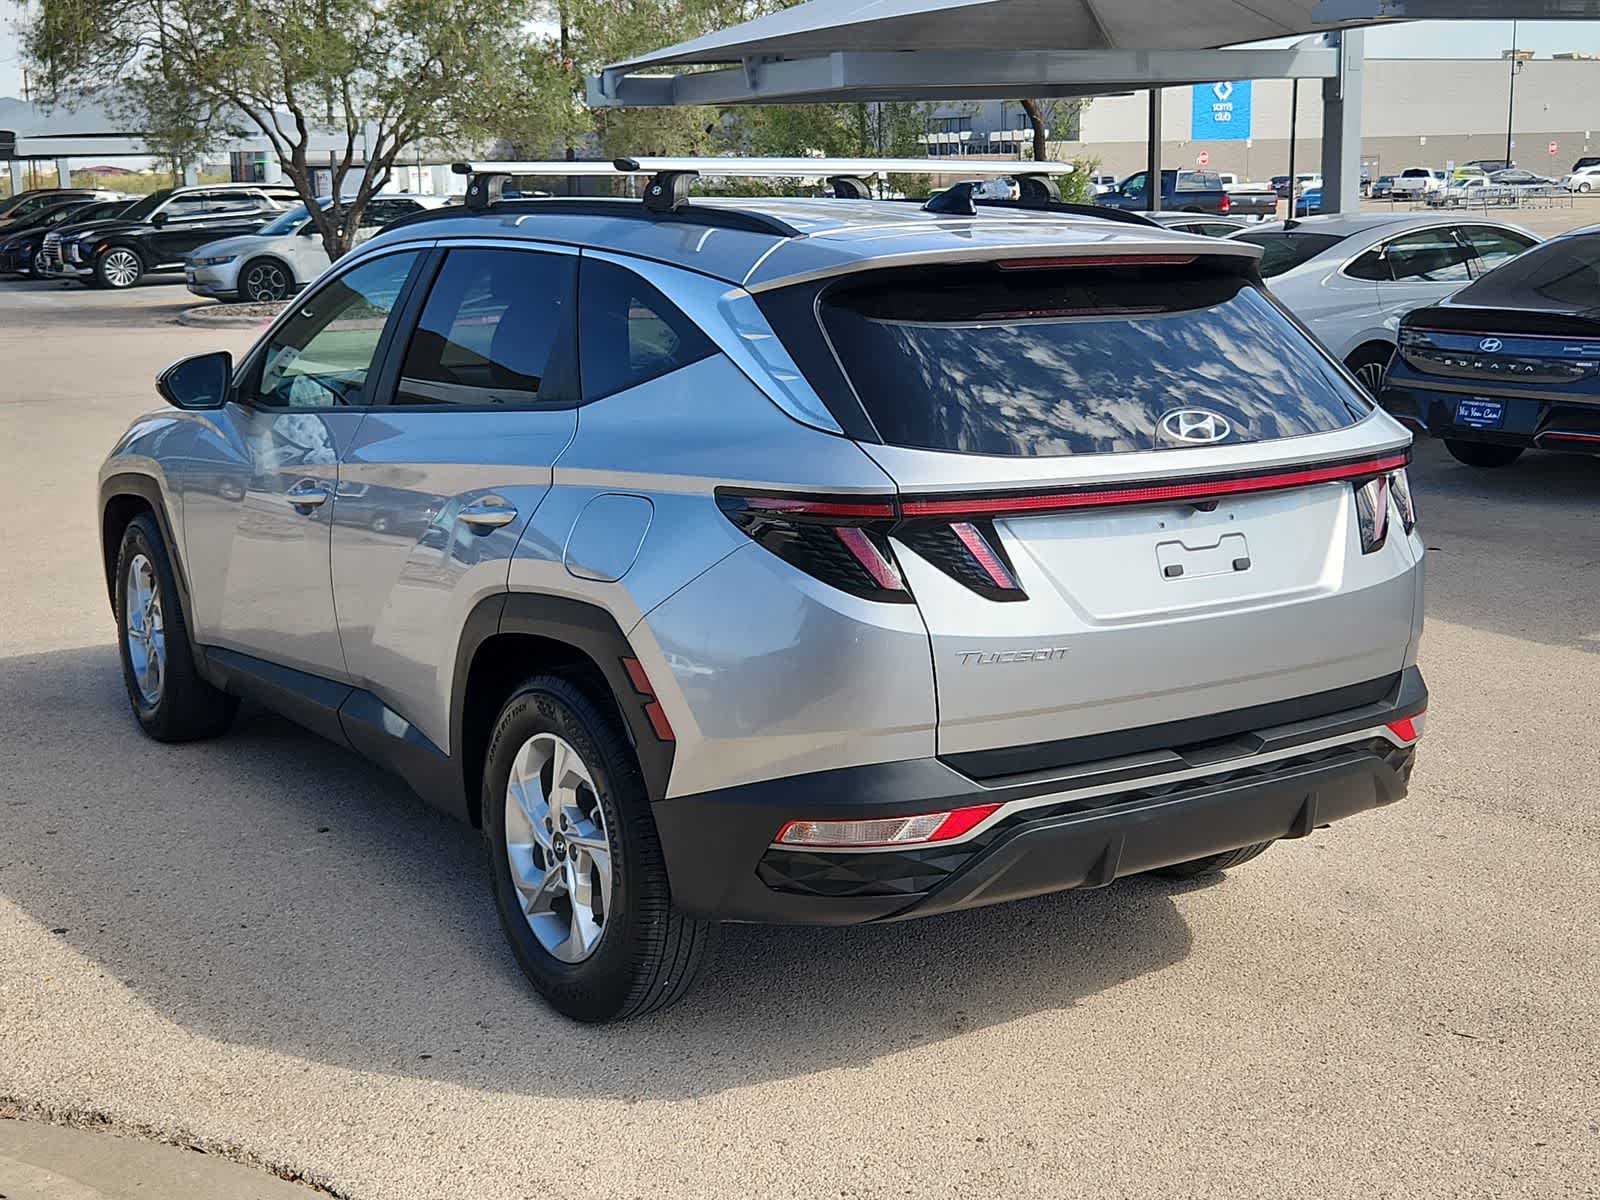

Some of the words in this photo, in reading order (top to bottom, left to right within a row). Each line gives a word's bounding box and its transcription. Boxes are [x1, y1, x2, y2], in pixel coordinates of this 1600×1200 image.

[1214, 112, 1231, 121] club
[1444, 359, 1534, 372] SONATA
[955, 647, 1069, 664] TUCSON
